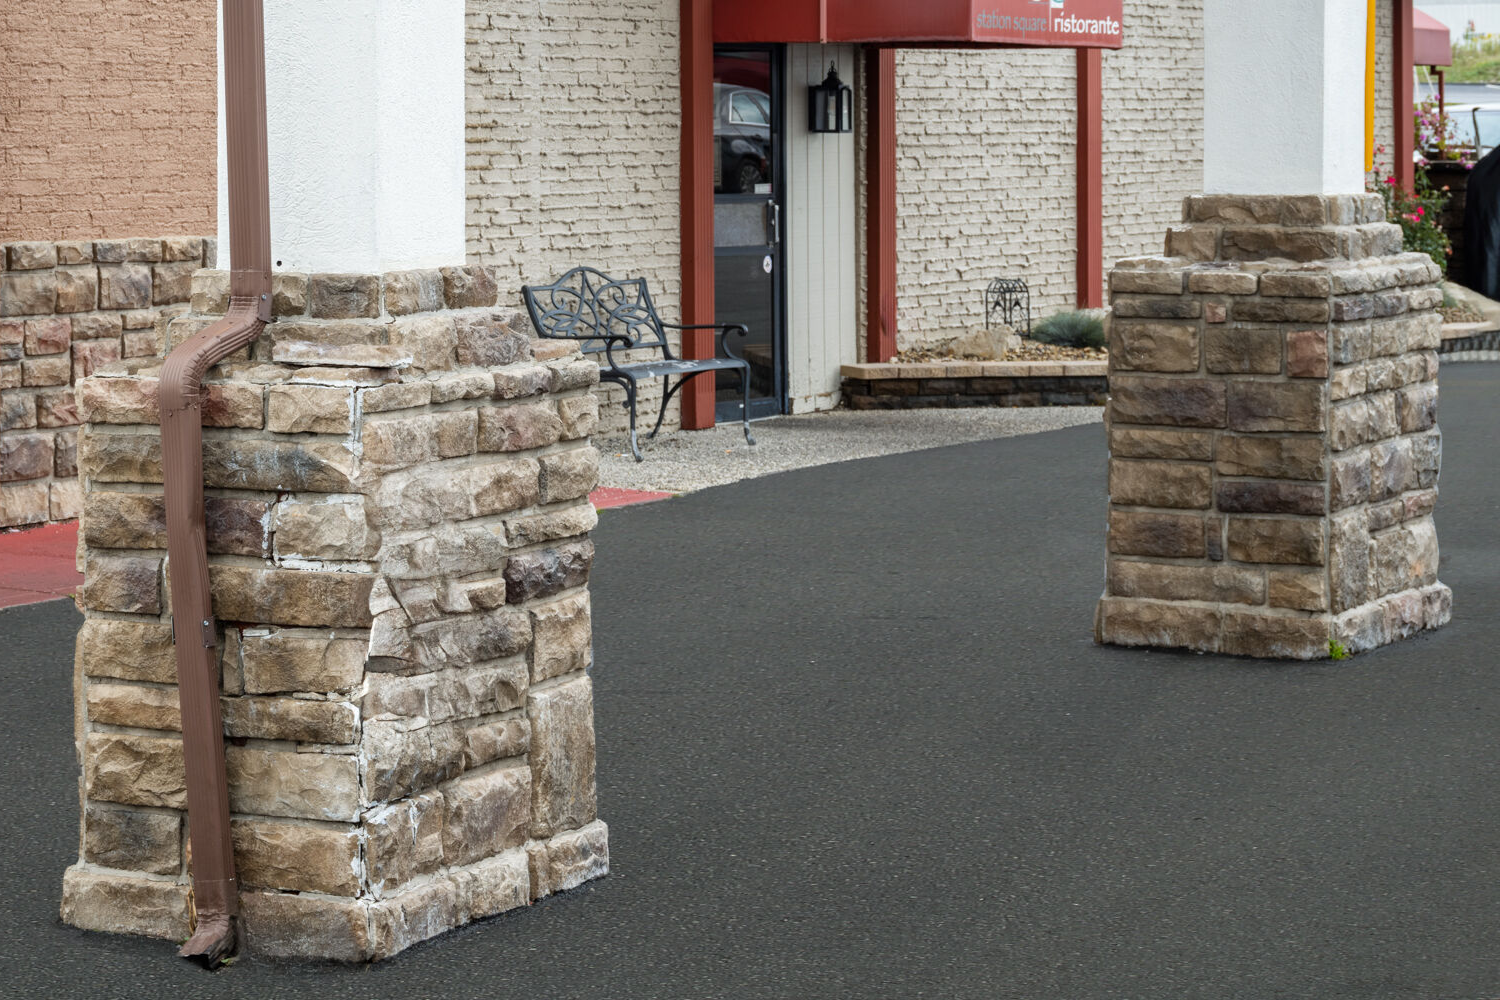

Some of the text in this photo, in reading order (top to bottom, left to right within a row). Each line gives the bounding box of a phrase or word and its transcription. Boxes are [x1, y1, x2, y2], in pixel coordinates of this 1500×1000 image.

[976, 8, 1120, 39] station square ristorante
